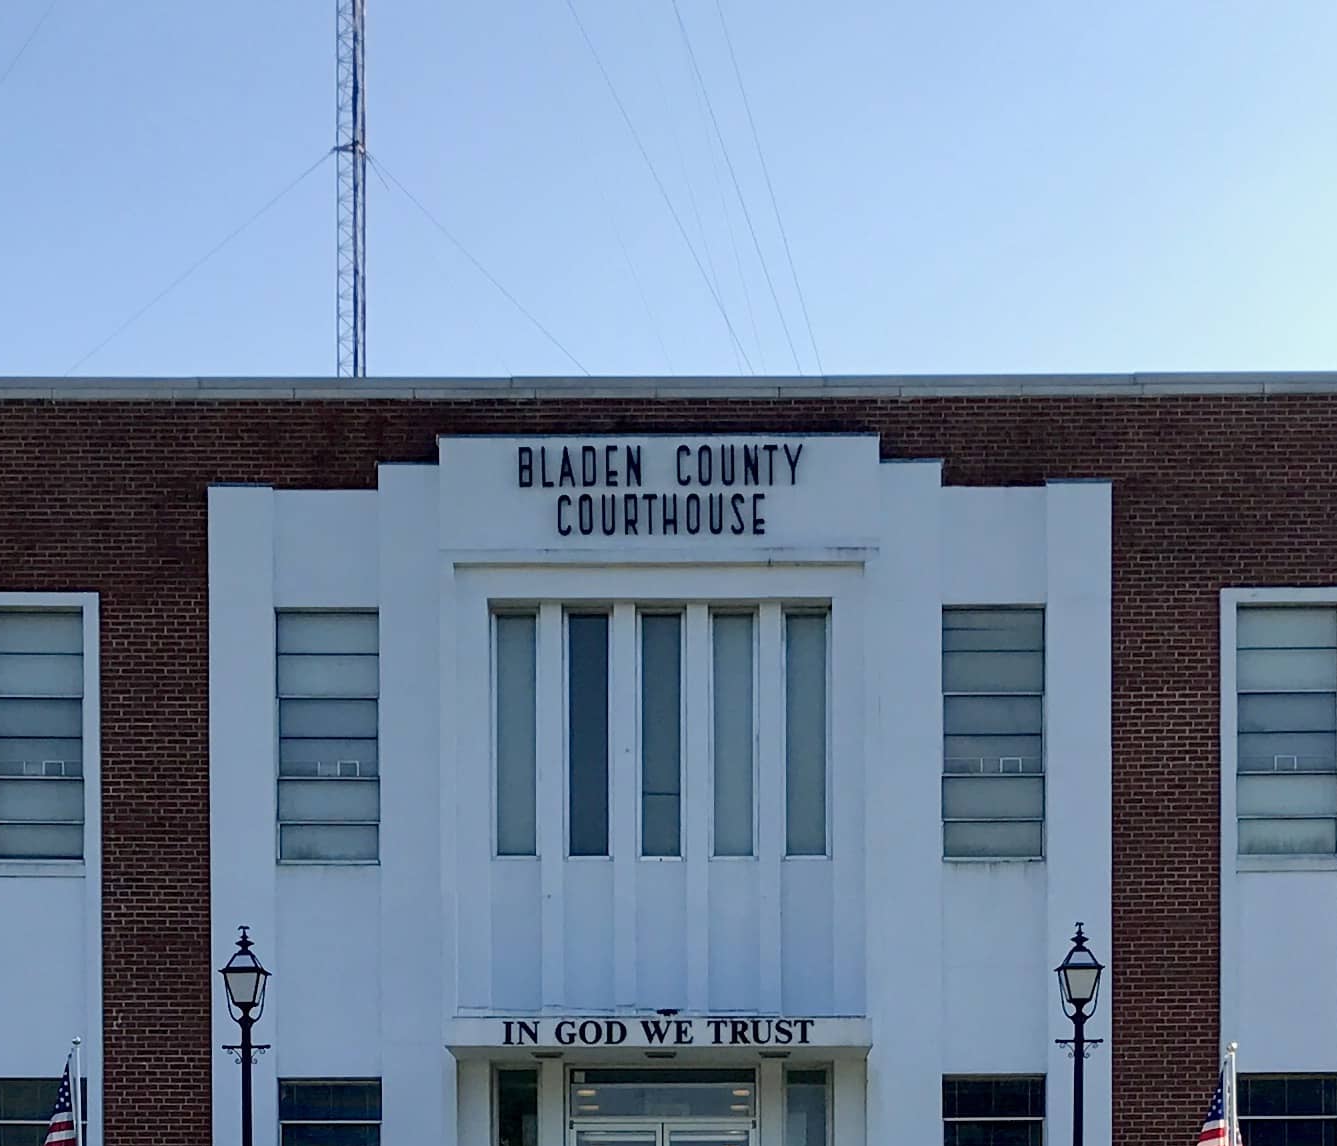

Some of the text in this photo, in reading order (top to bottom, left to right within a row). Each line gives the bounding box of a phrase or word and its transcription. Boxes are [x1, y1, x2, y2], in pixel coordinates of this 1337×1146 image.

[518, 443, 804, 488] BLADEN COUNTY
[557, 492, 766, 537] COURTHOUSE
[502, 1019, 815, 1045] IN GOD WE TRUST
